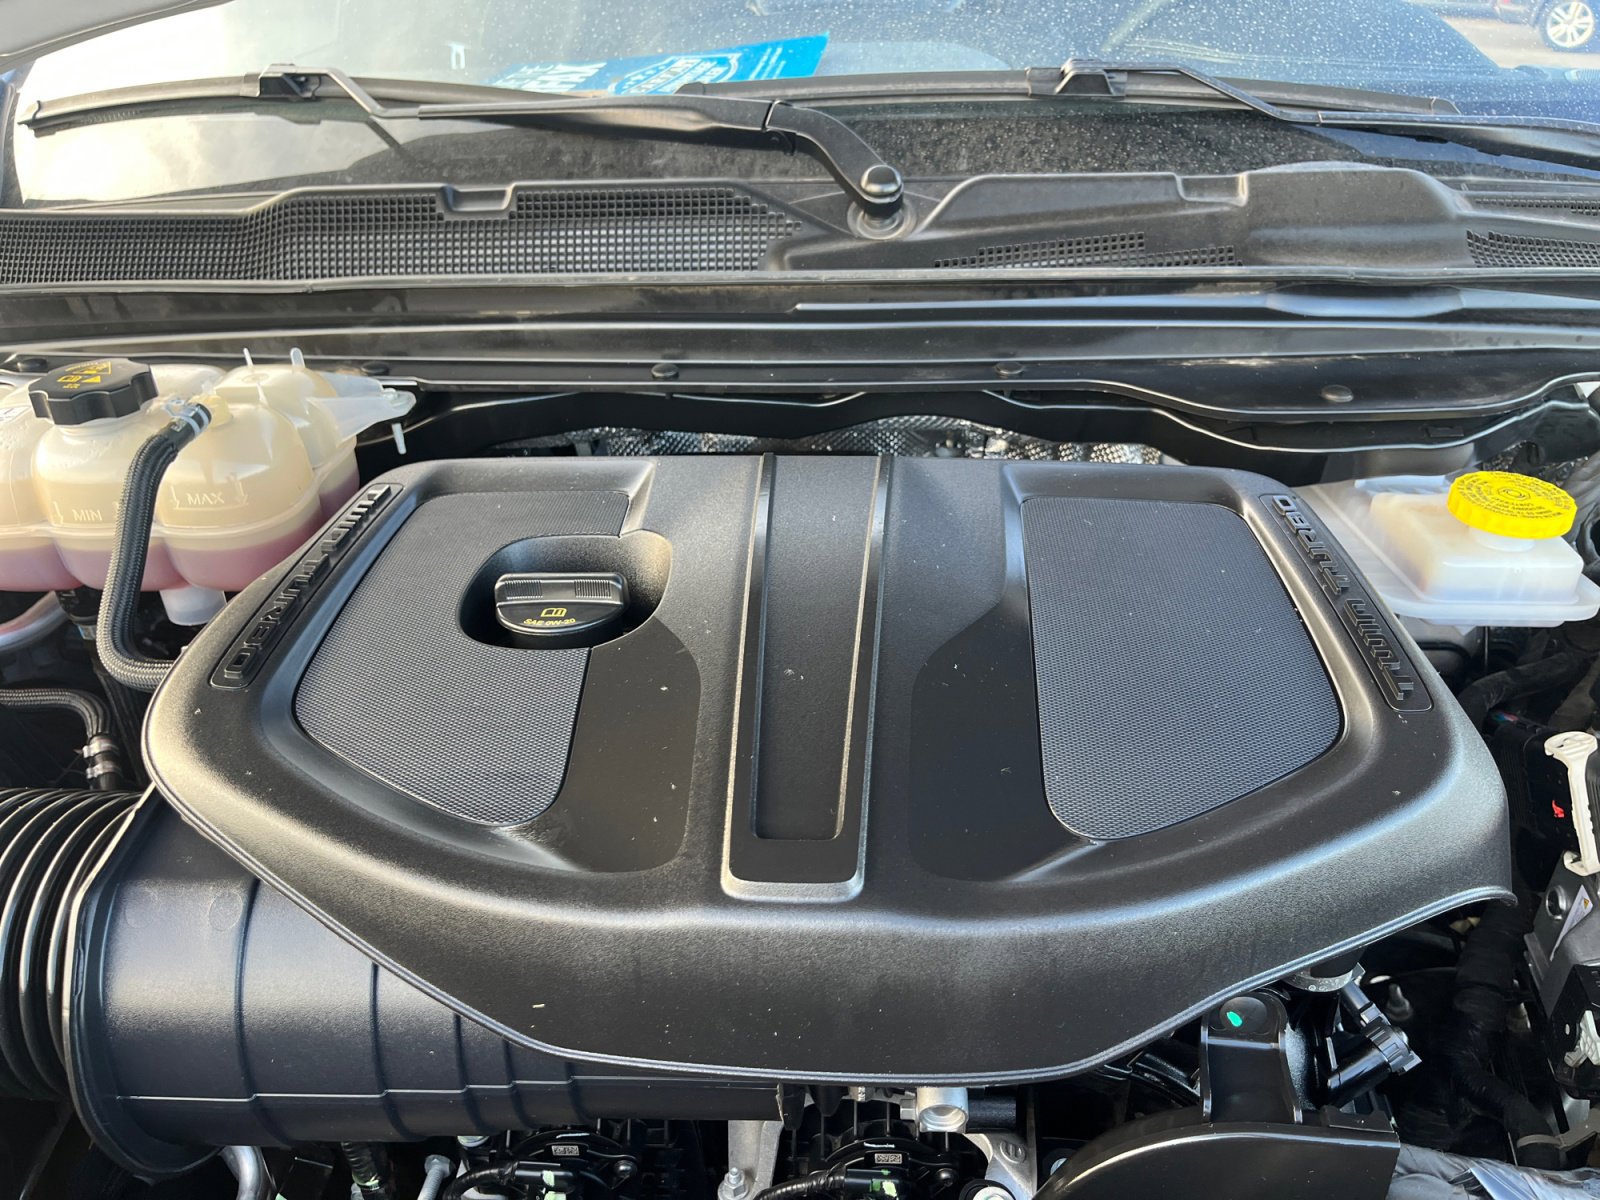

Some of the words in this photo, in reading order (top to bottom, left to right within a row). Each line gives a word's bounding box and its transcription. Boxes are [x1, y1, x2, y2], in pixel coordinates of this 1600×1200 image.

[186, 492, 225, 505] MAX
[72, 508, 103, 522] MIN
[1272, 495, 1350, 595] TURBO
[224, 553, 330, 679] TURBO
[523, 618, 545, 626] SAE
[545, 617, 576, 626] 0W-20
